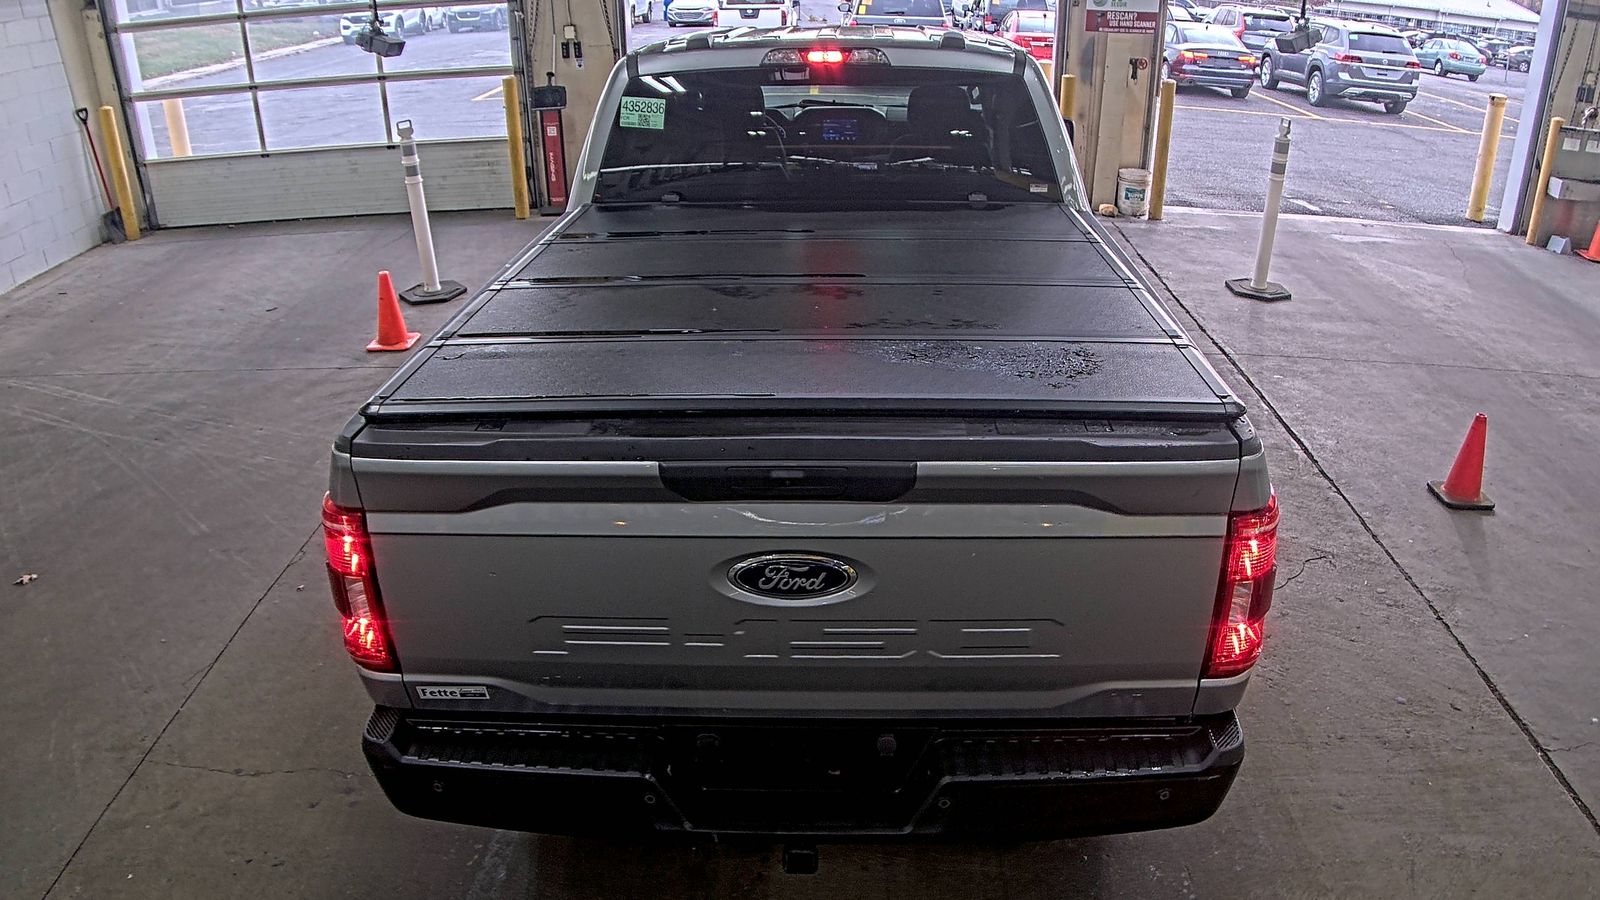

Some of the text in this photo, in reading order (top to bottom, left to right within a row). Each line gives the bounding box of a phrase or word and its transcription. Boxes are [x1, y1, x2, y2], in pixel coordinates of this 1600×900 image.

[1106, 11, 1138, 20] RESCAN?
[1134, 20, 1156, 28] SCANNER
[622, 100, 665, 114] 4352836
[758, 564, 827, 591] Ford
[420, 688, 458, 697] Fette
